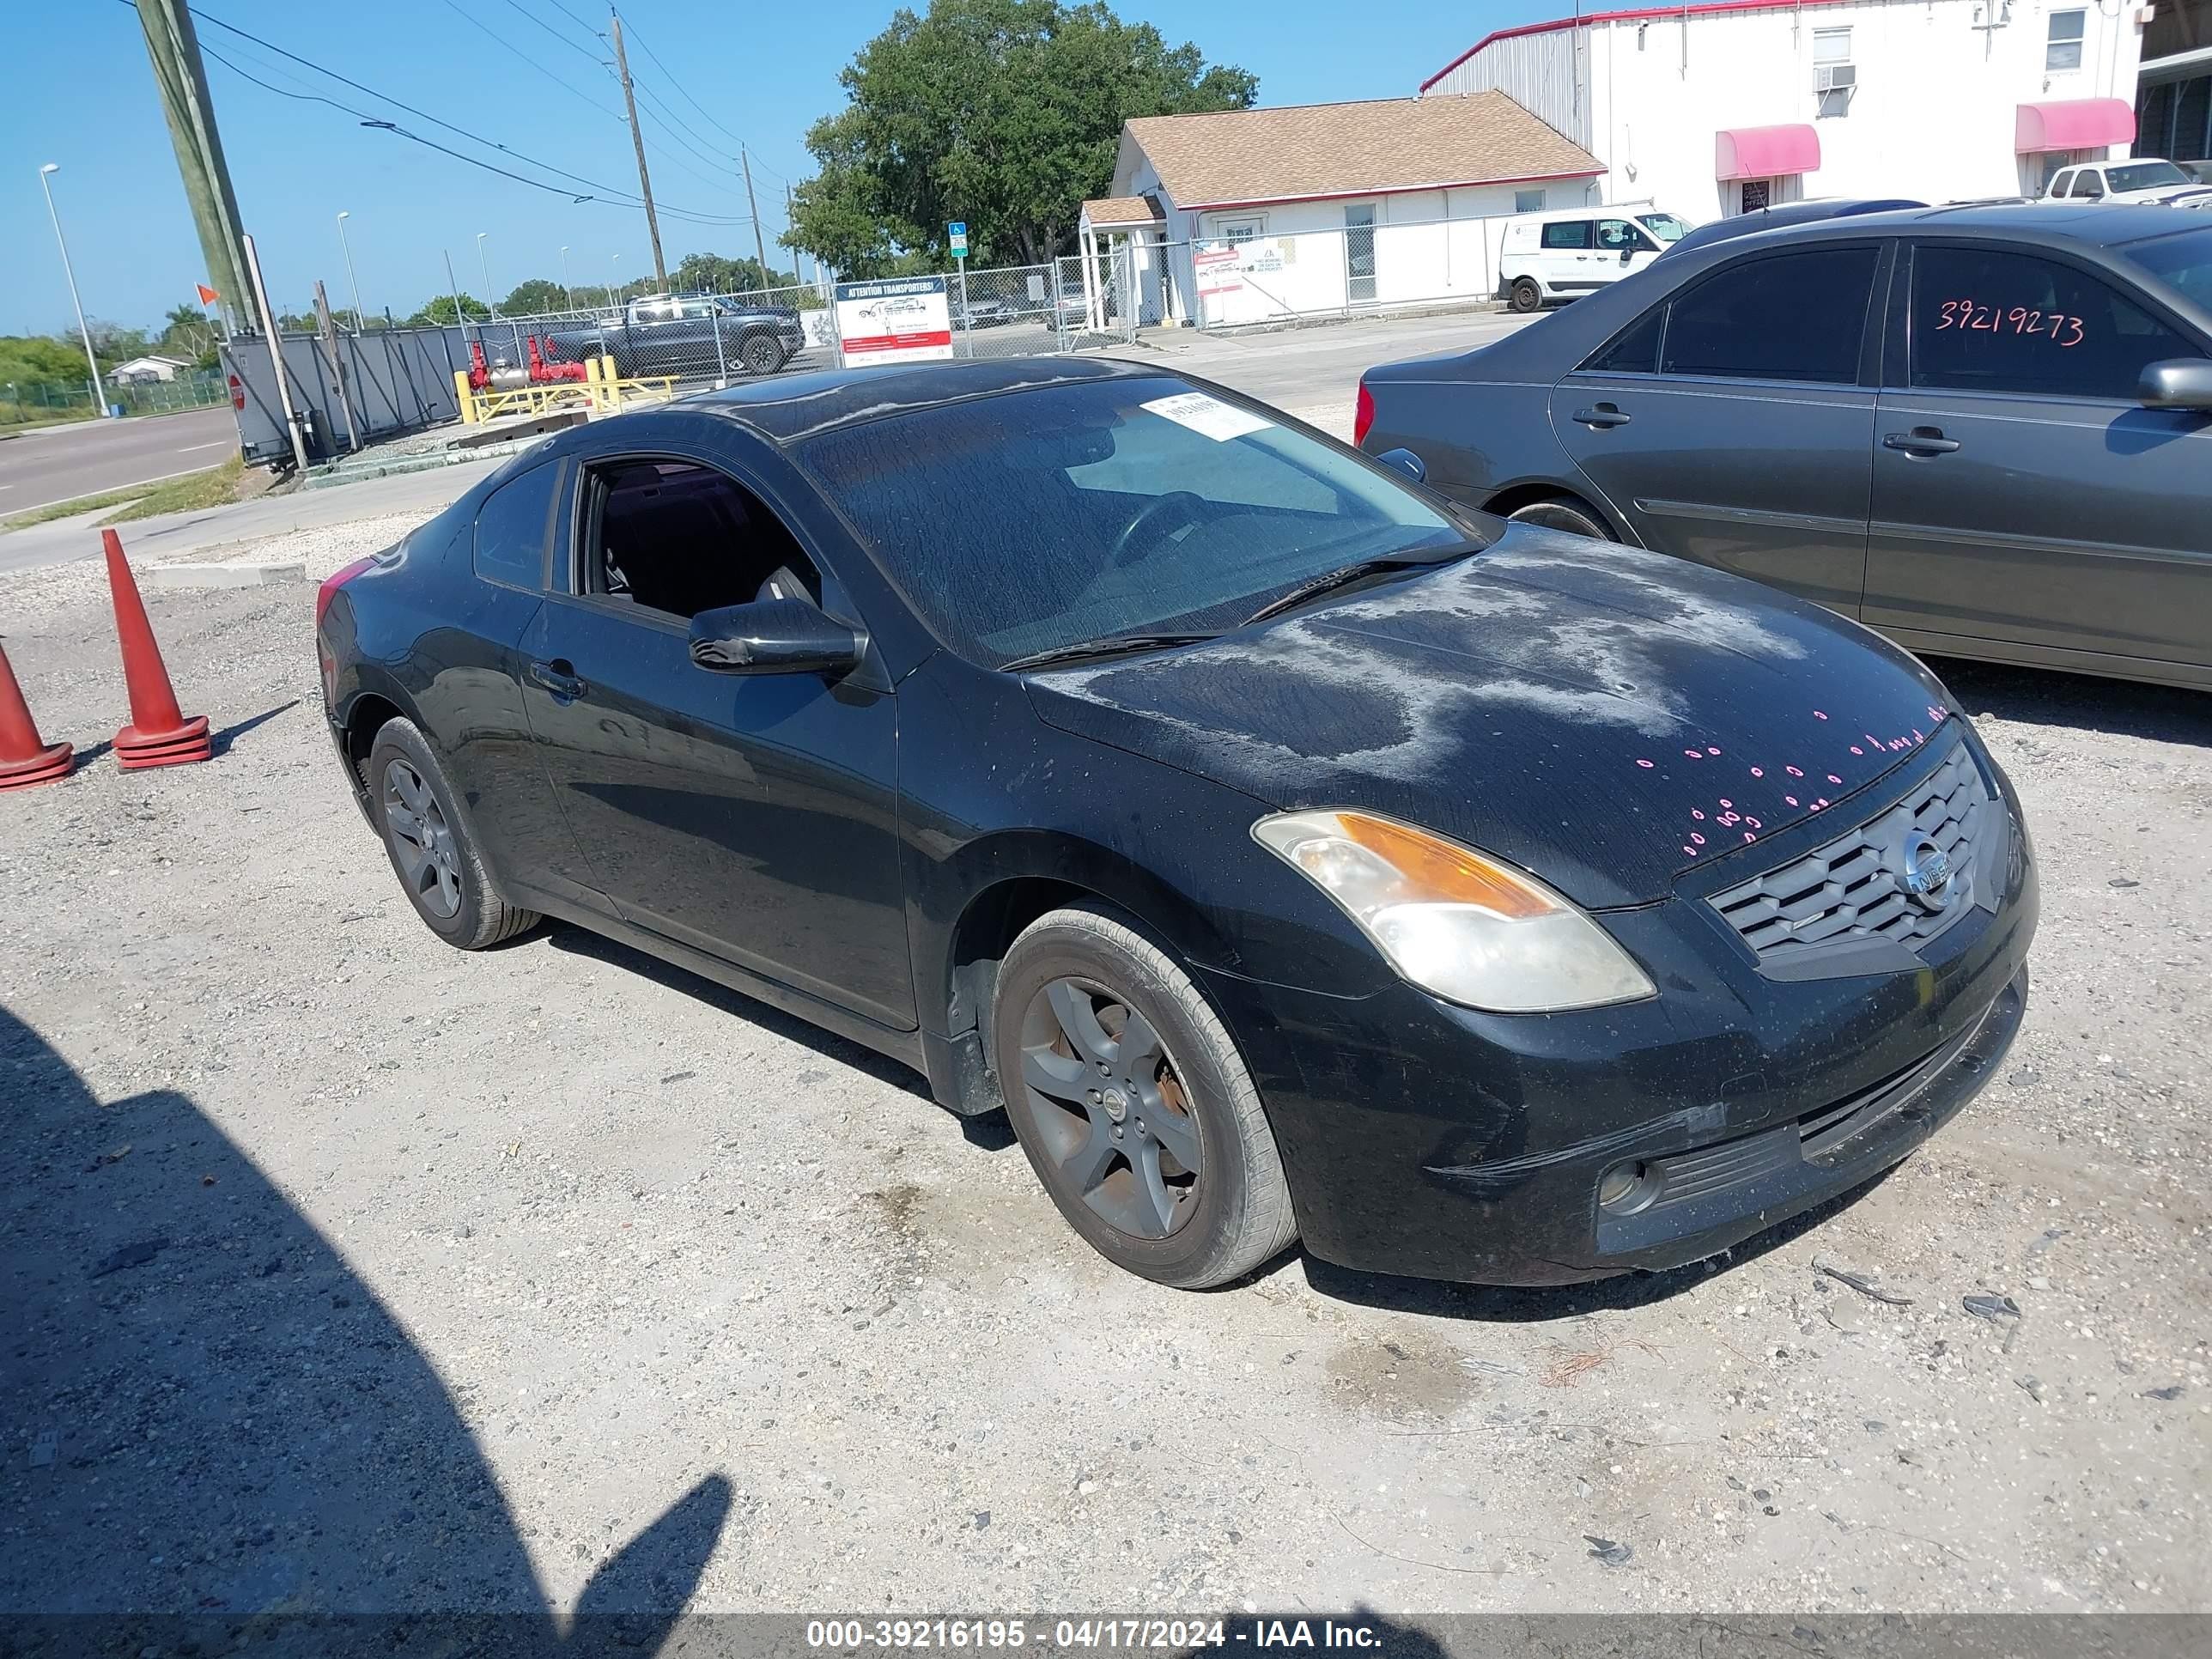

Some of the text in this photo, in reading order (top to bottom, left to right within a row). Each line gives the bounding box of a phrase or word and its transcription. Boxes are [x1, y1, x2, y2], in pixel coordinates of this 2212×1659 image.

[848, 282, 933, 298] ATTENTION TRANSPORTERS!
[1935, 300, 2084, 347] 39219273
